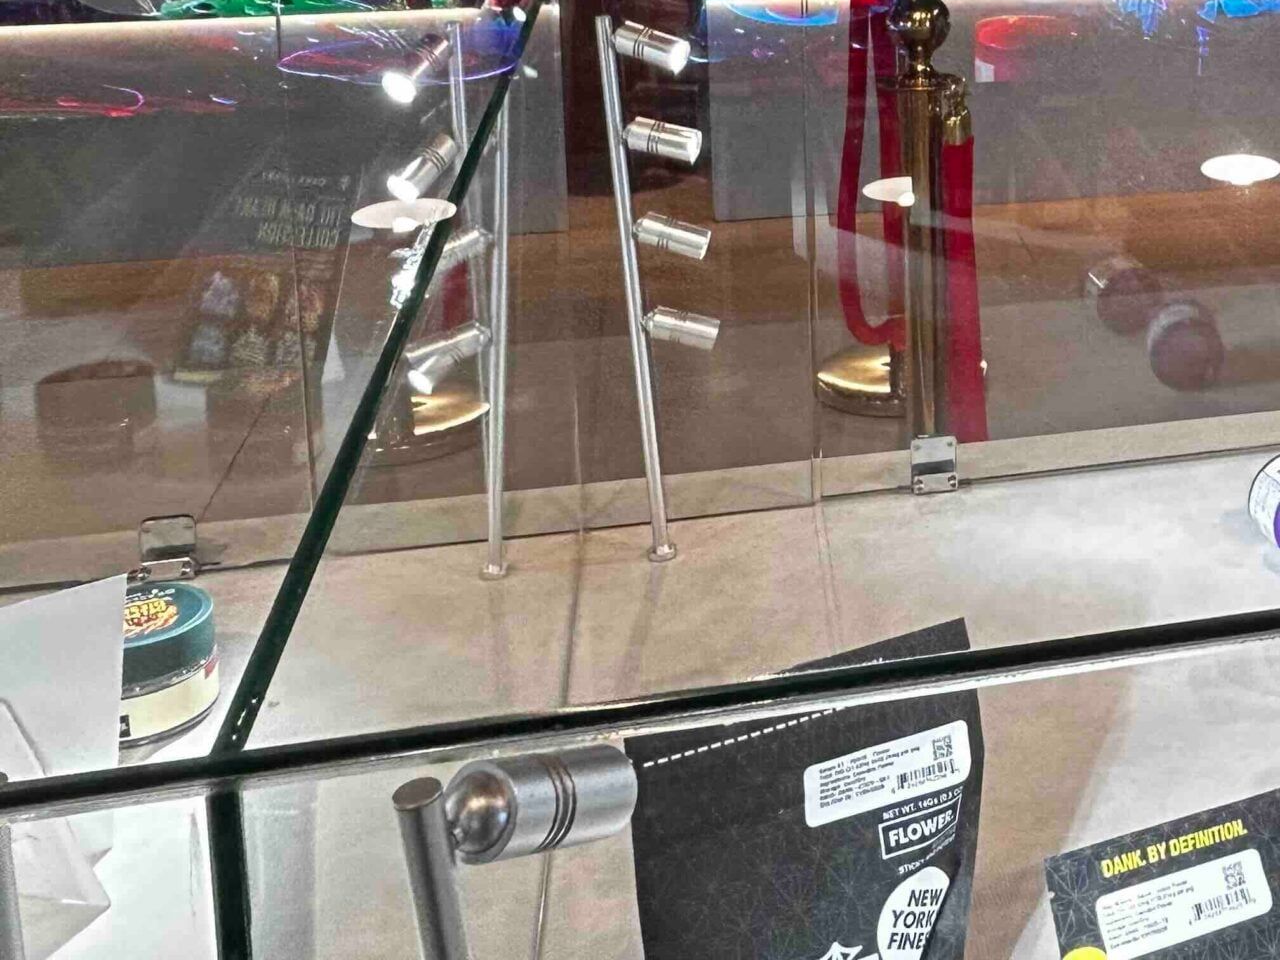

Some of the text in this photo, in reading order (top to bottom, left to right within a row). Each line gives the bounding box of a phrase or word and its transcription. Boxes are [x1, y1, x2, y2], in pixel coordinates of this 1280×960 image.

[888, 809, 955, 848] FLOWER.
[1101, 818, 1249, 878] DANK. BY DEFINITION.
[907, 888, 944, 907] NEW
[892, 909, 936, 929] YORK
